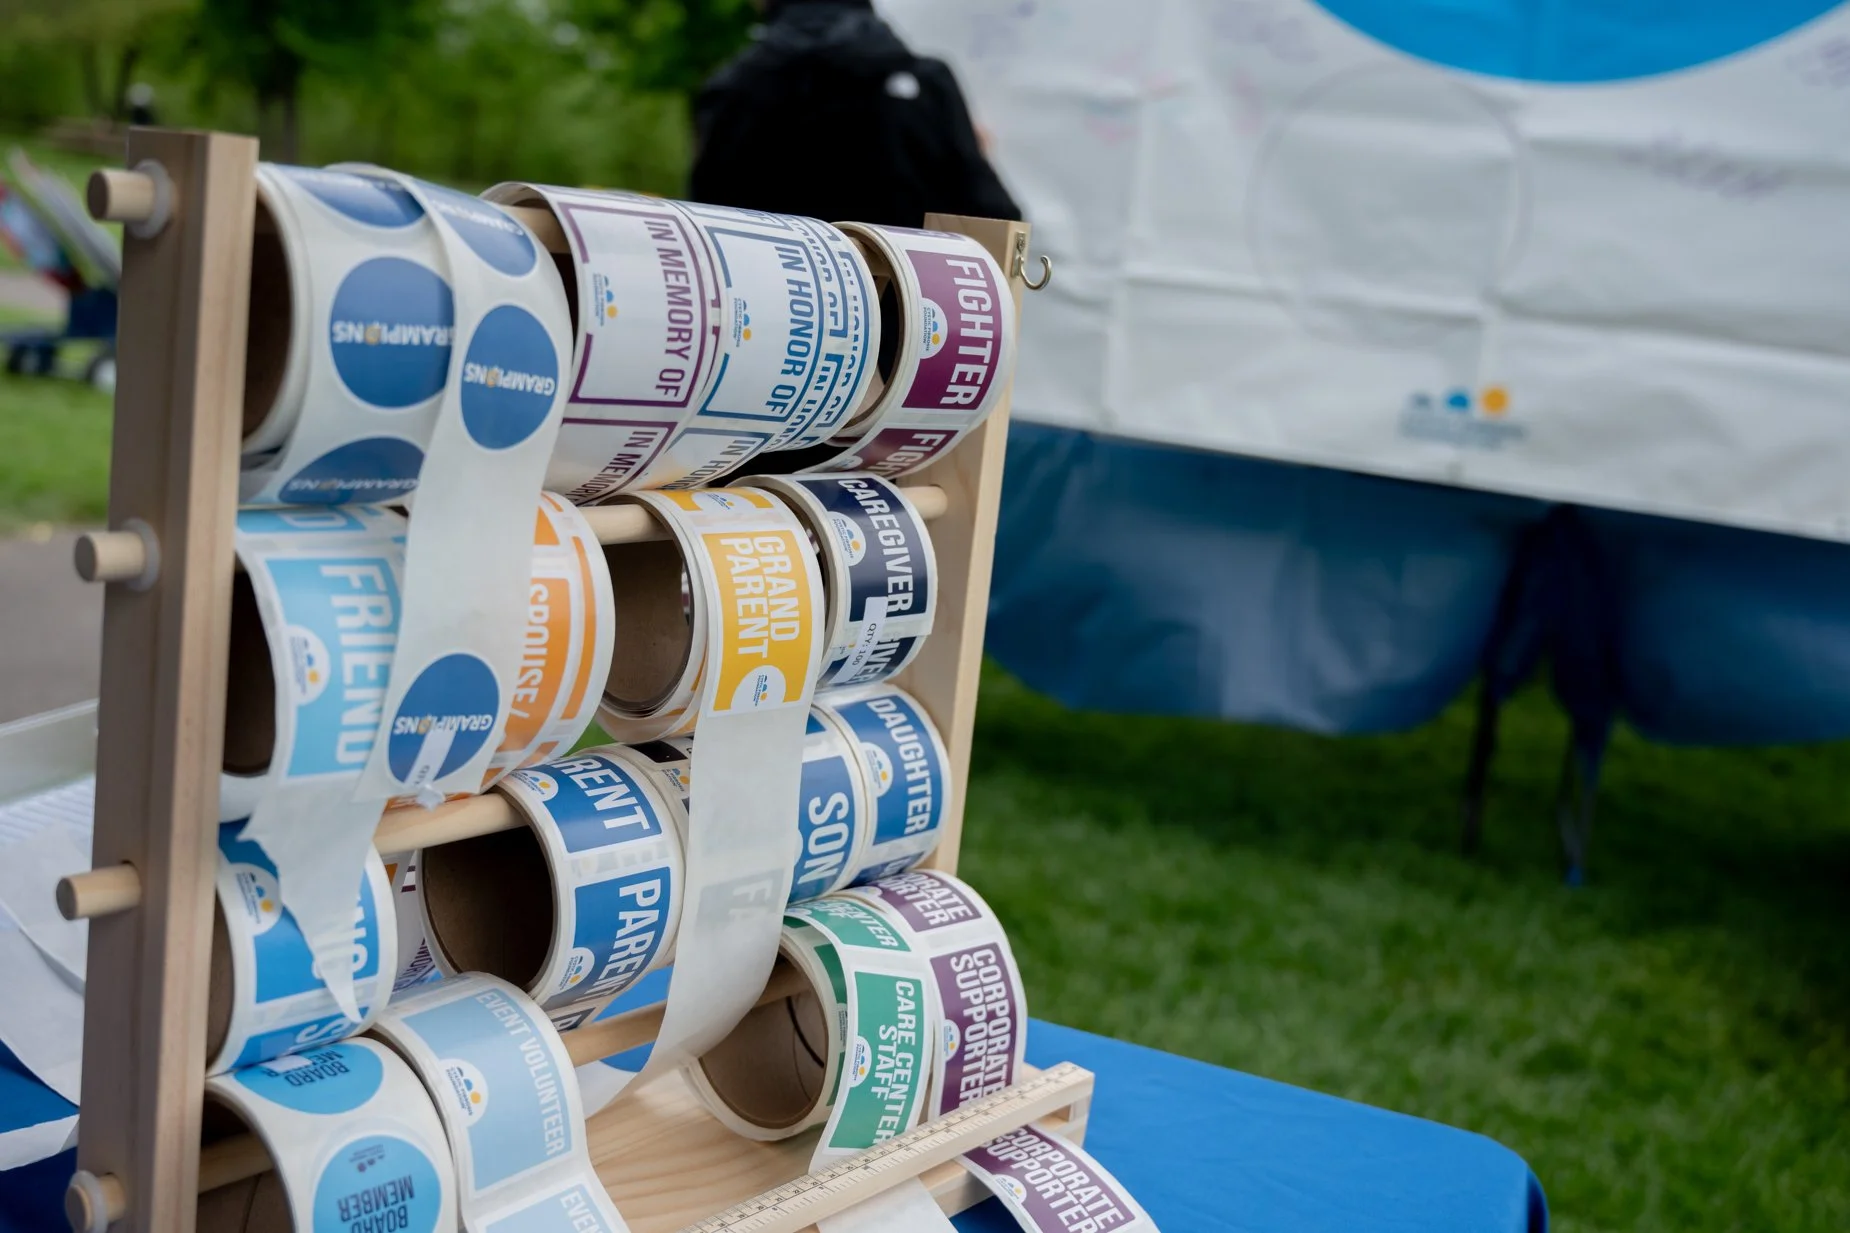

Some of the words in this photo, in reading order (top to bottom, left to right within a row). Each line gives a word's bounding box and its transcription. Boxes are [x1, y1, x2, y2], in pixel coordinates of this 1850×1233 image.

[643, 220, 675, 242] IN
[774, 246, 807, 273] IN
[656, 248, 693, 365] MEMORY
[781, 278, 814, 376] HONOR
[940, 258, 994, 406] FIGHTER
[464, 362, 555, 397] GRAMPIONS
[655, 369, 686, 398] OF
[765, 384, 797, 414] OF
[623, 431, 659, 449] IN
[656, 459, 732, 491] HONO
[714, 439, 757, 457] IN
[753, 536, 801, 642] GRAND
[838, 479, 913, 614] CAREGIVER
[720, 538, 769, 659] PARENT
[320, 565, 398, 764] FRIEND
[549, 757, 650, 830] RENT
[867, 698, 933, 835] DAUGHTER
[797, 792, 849, 885] SON
[575, 878, 661, 1001] PARENT
[895, 981, 916, 1047] CARE
[950, 953, 988, 1107] SUPPORTER
[973, 949, 1011, 1097] CORPORATE
[284, 1060, 350, 1087] BOARD
[476, 990, 533, 1037] EVENT
[519, 1036, 565, 1155] VOLUNTEER
[870, 1024, 898, 1102] STAFF
[872, 1051, 914, 1144] CENTER
[337, 1175, 415, 1223] MEMBER
[1006, 1127, 1126, 1233] CORPORATE
